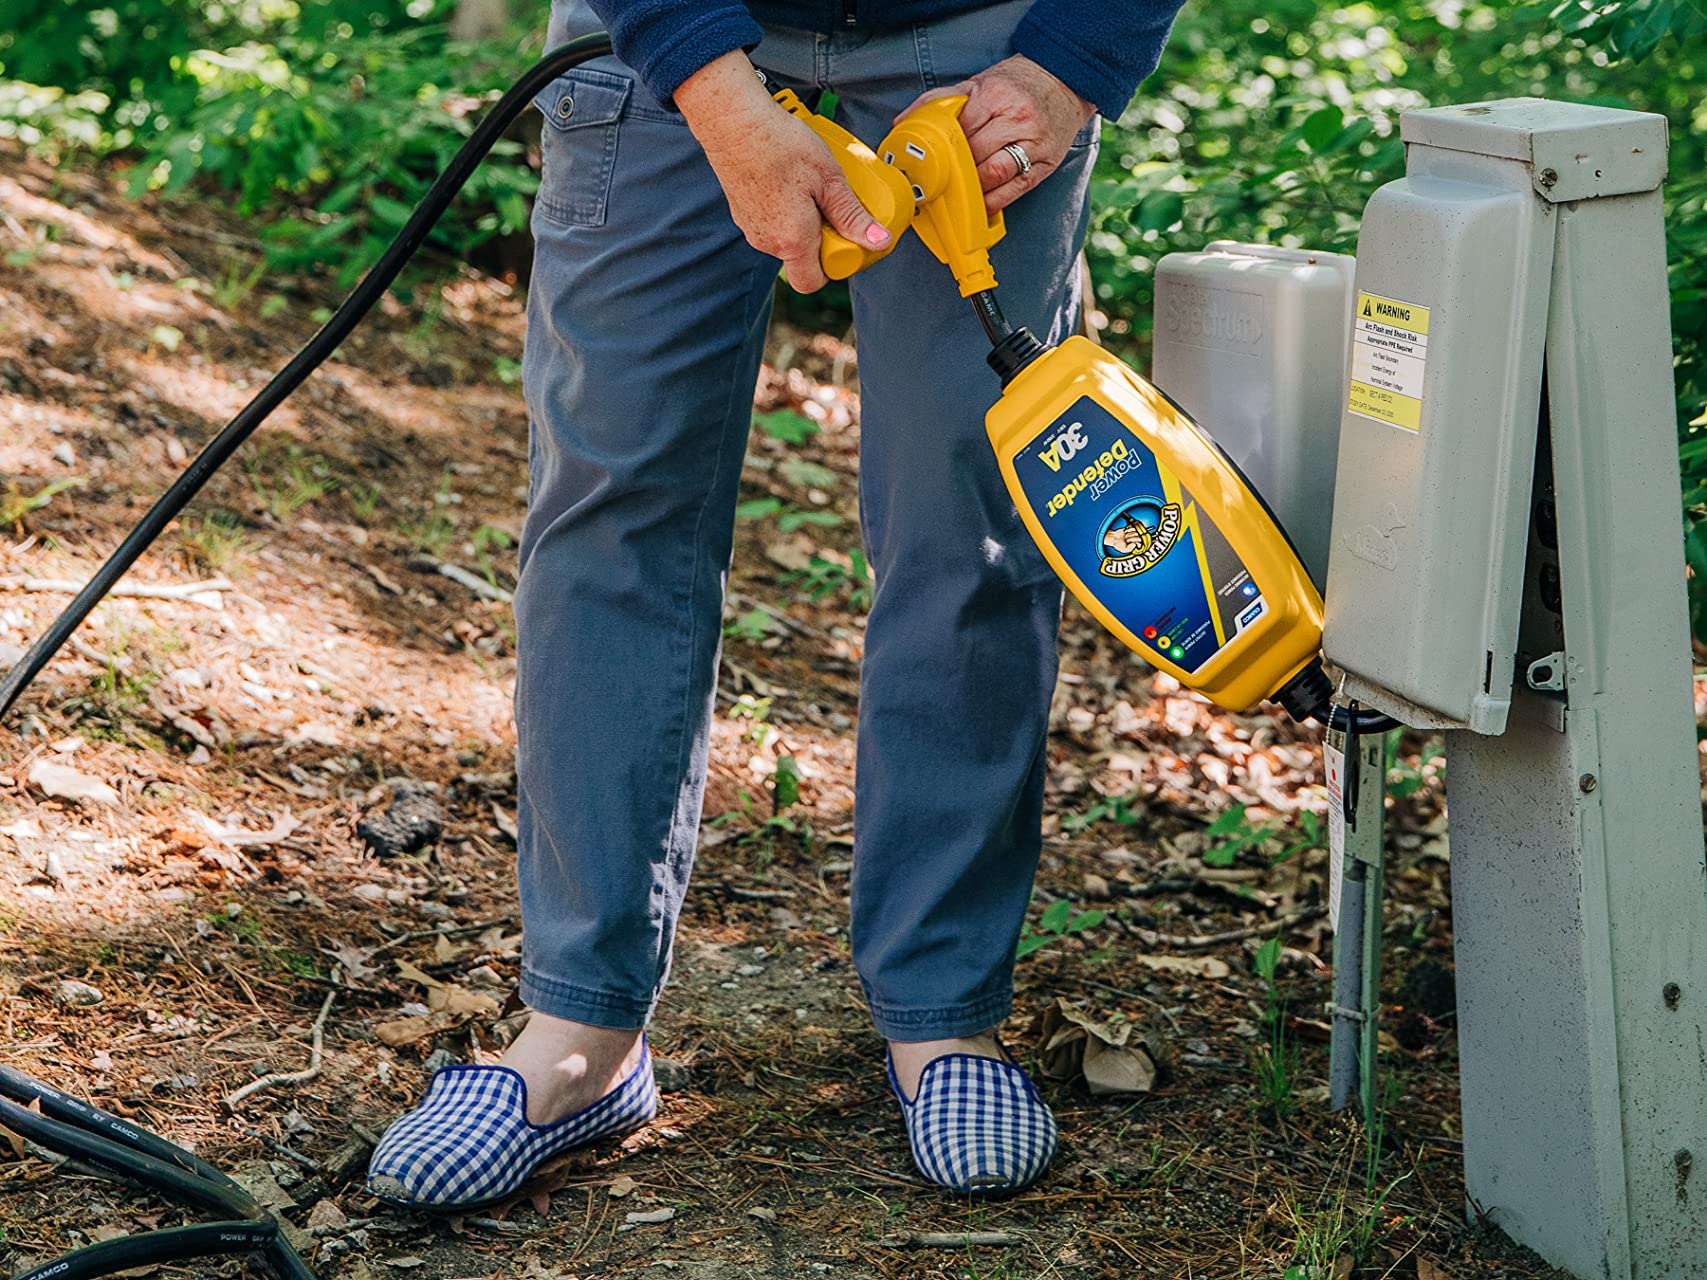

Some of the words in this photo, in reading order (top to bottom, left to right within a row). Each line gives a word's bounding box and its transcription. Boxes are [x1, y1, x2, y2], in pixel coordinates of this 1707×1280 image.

[1376, 302, 1411, 321] WARNING
[1373, 324, 1385, 333] Flash
[1385, 328, 1393, 336] and
[1393, 330, 1407, 339] Shock
[1408, 333, 1417, 342] Risk
[1037, 422, 1089, 473] 30A
[1046, 438, 1129, 518] Defender
[1088, 447, 1143, 502] Power
[1145, 508, 1178, 562] POWER
[1105, 555, 1146, 574] GRIP
[110, 1122, 139, 1140] CAMCO
[220, 1233, 247, 1241] POWER
